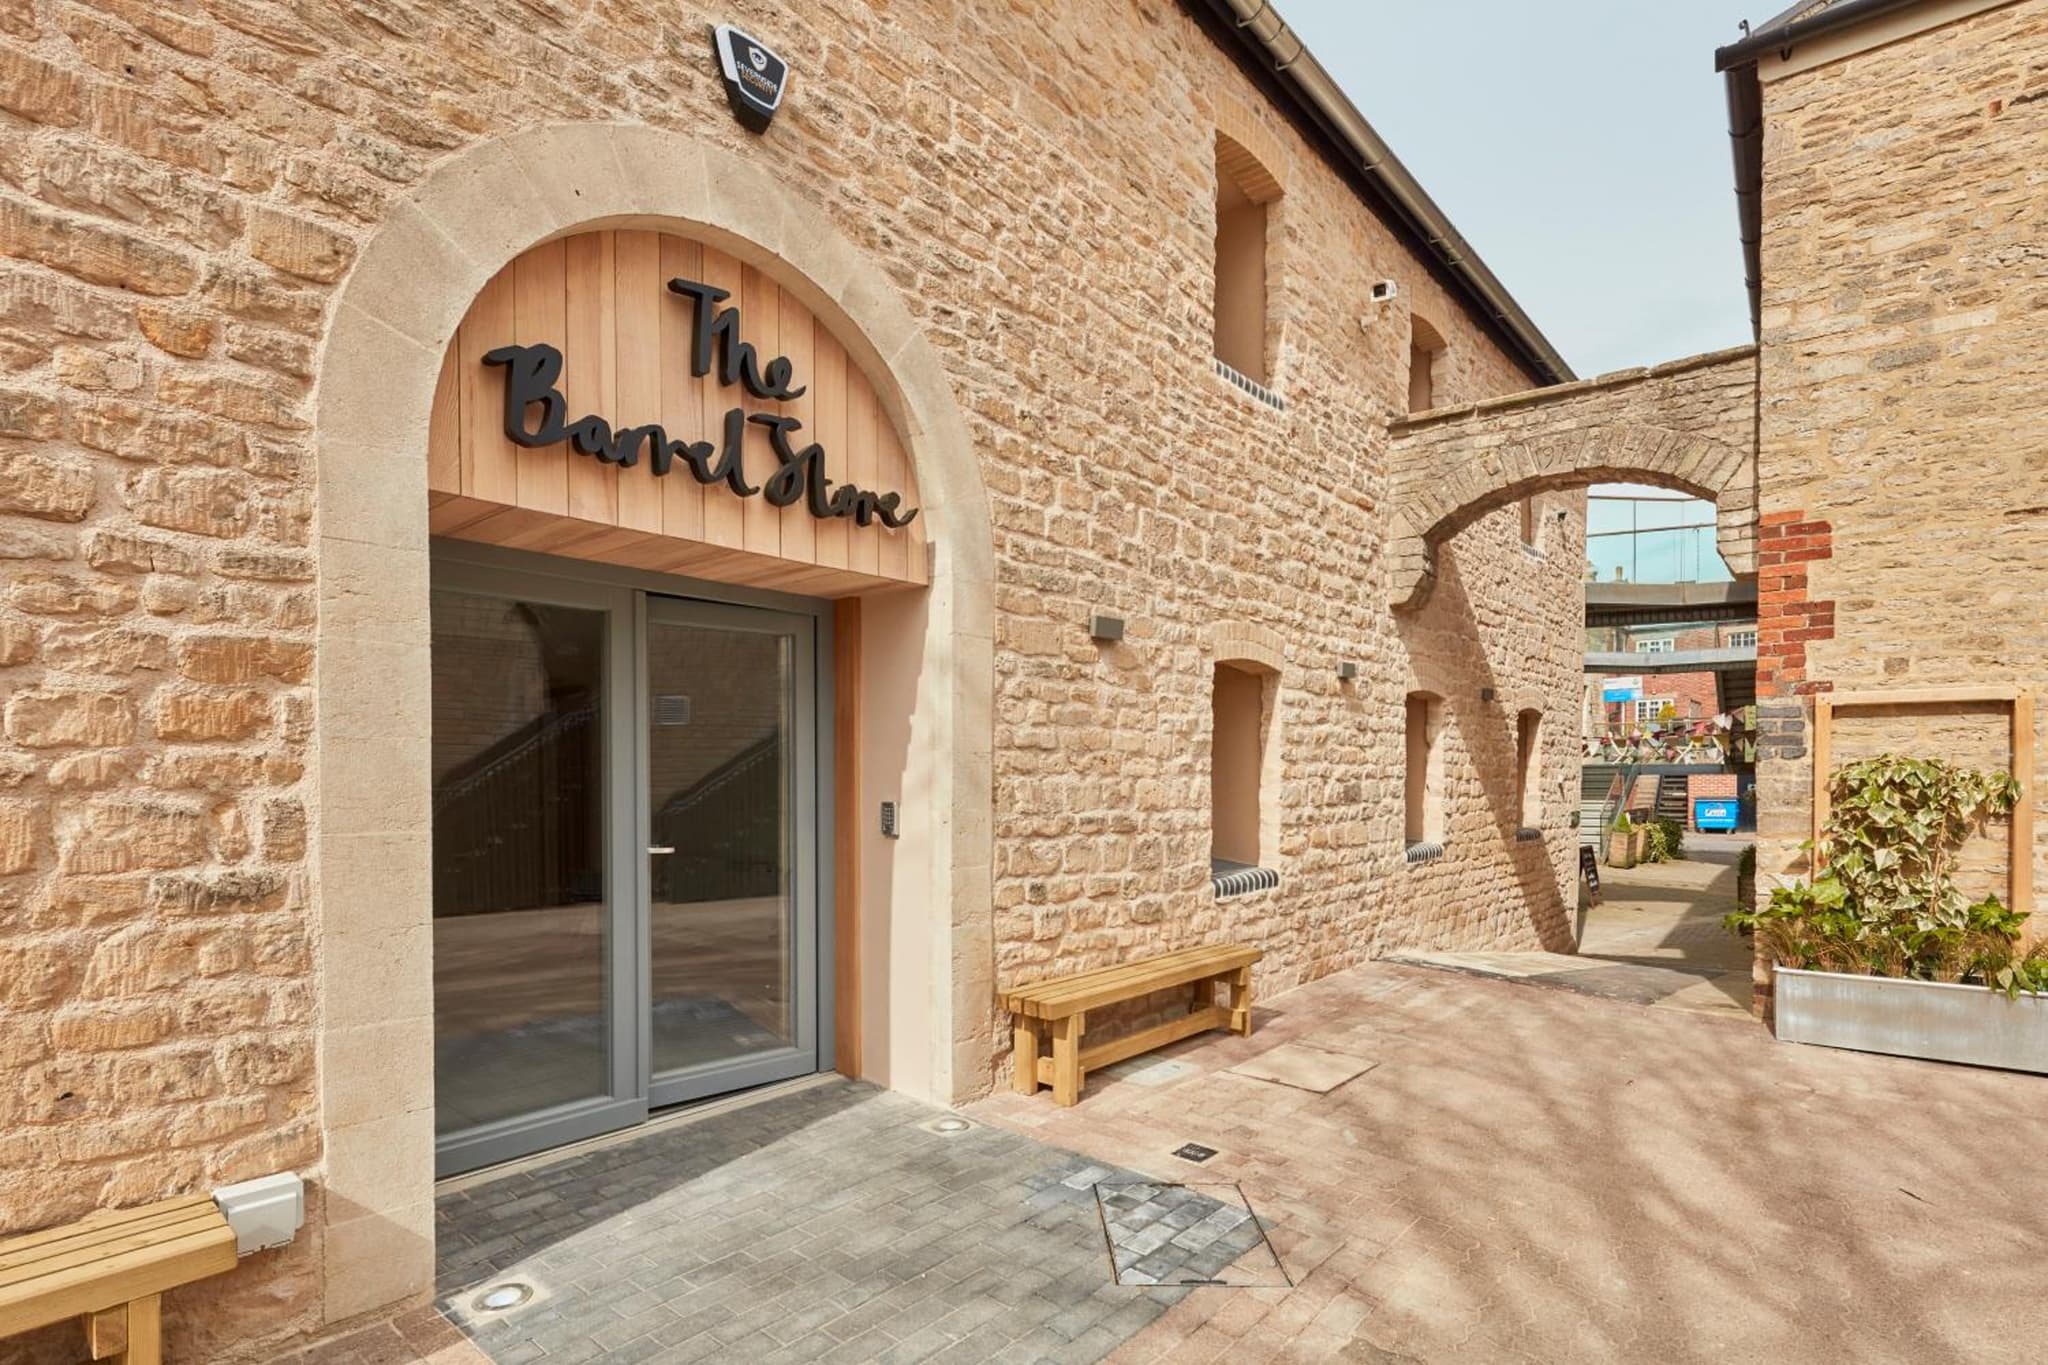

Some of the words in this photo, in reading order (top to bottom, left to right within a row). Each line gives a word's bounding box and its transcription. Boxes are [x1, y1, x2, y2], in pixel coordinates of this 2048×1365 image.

[667, 277, 806, 400] The
[481, 343, 759, 497] Barrel
[747, 413, 918, 529] Store
